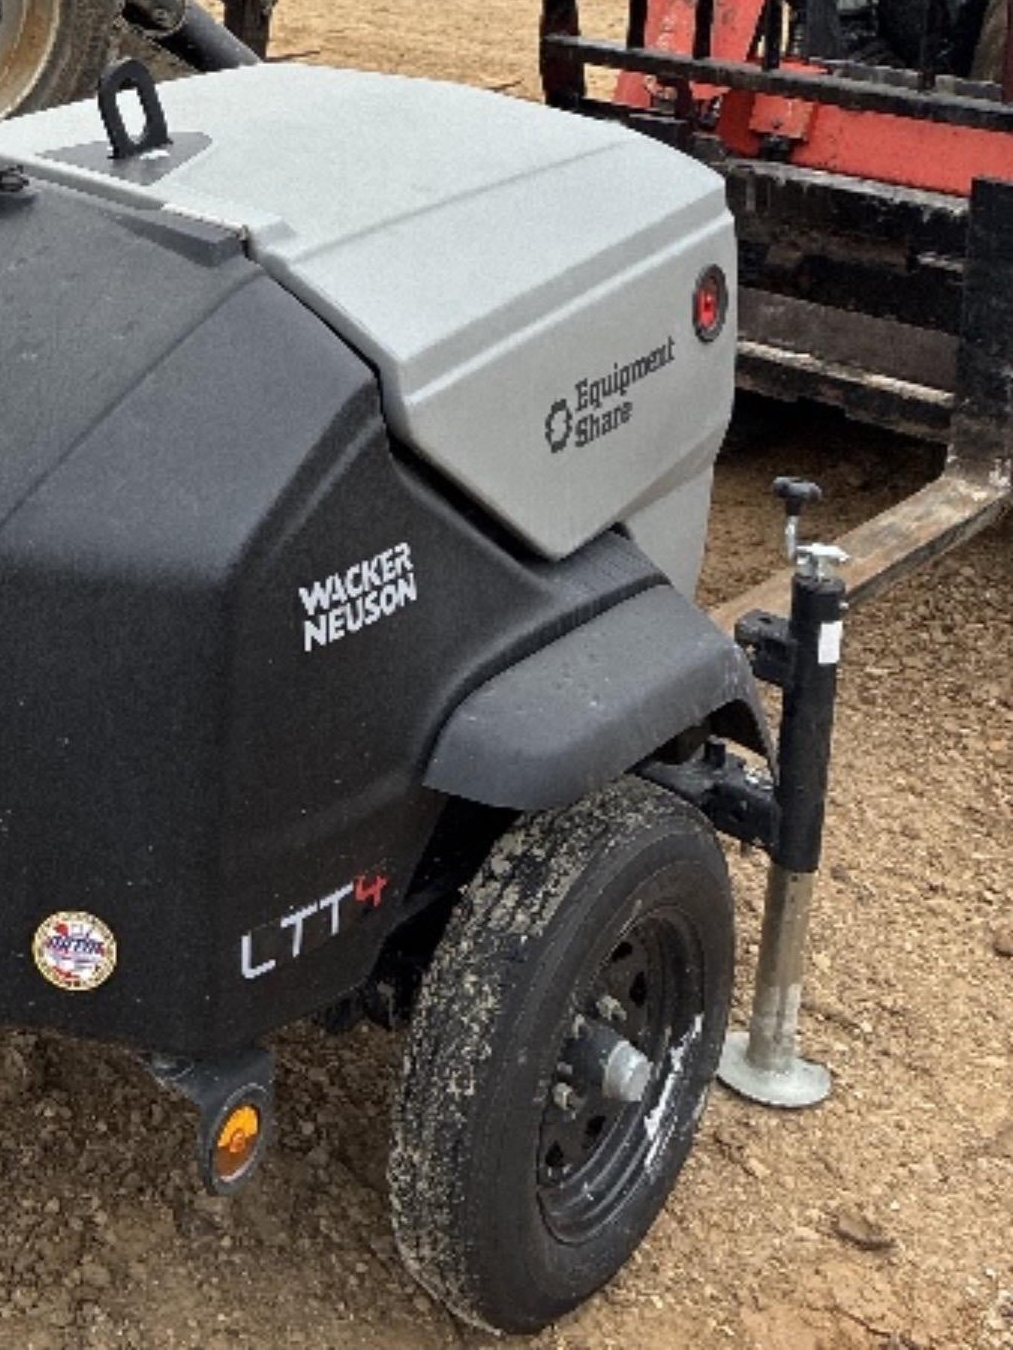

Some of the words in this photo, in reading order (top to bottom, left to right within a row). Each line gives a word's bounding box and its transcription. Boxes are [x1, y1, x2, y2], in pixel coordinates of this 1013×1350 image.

[574, 334, 675, 413] Equipment
[574, 401, 633, 448] Share
[298, 541, 414, 617] WACKER
[304, 571, 417, 652] NEUSON
[241, 873, 389, 980] LTT4
